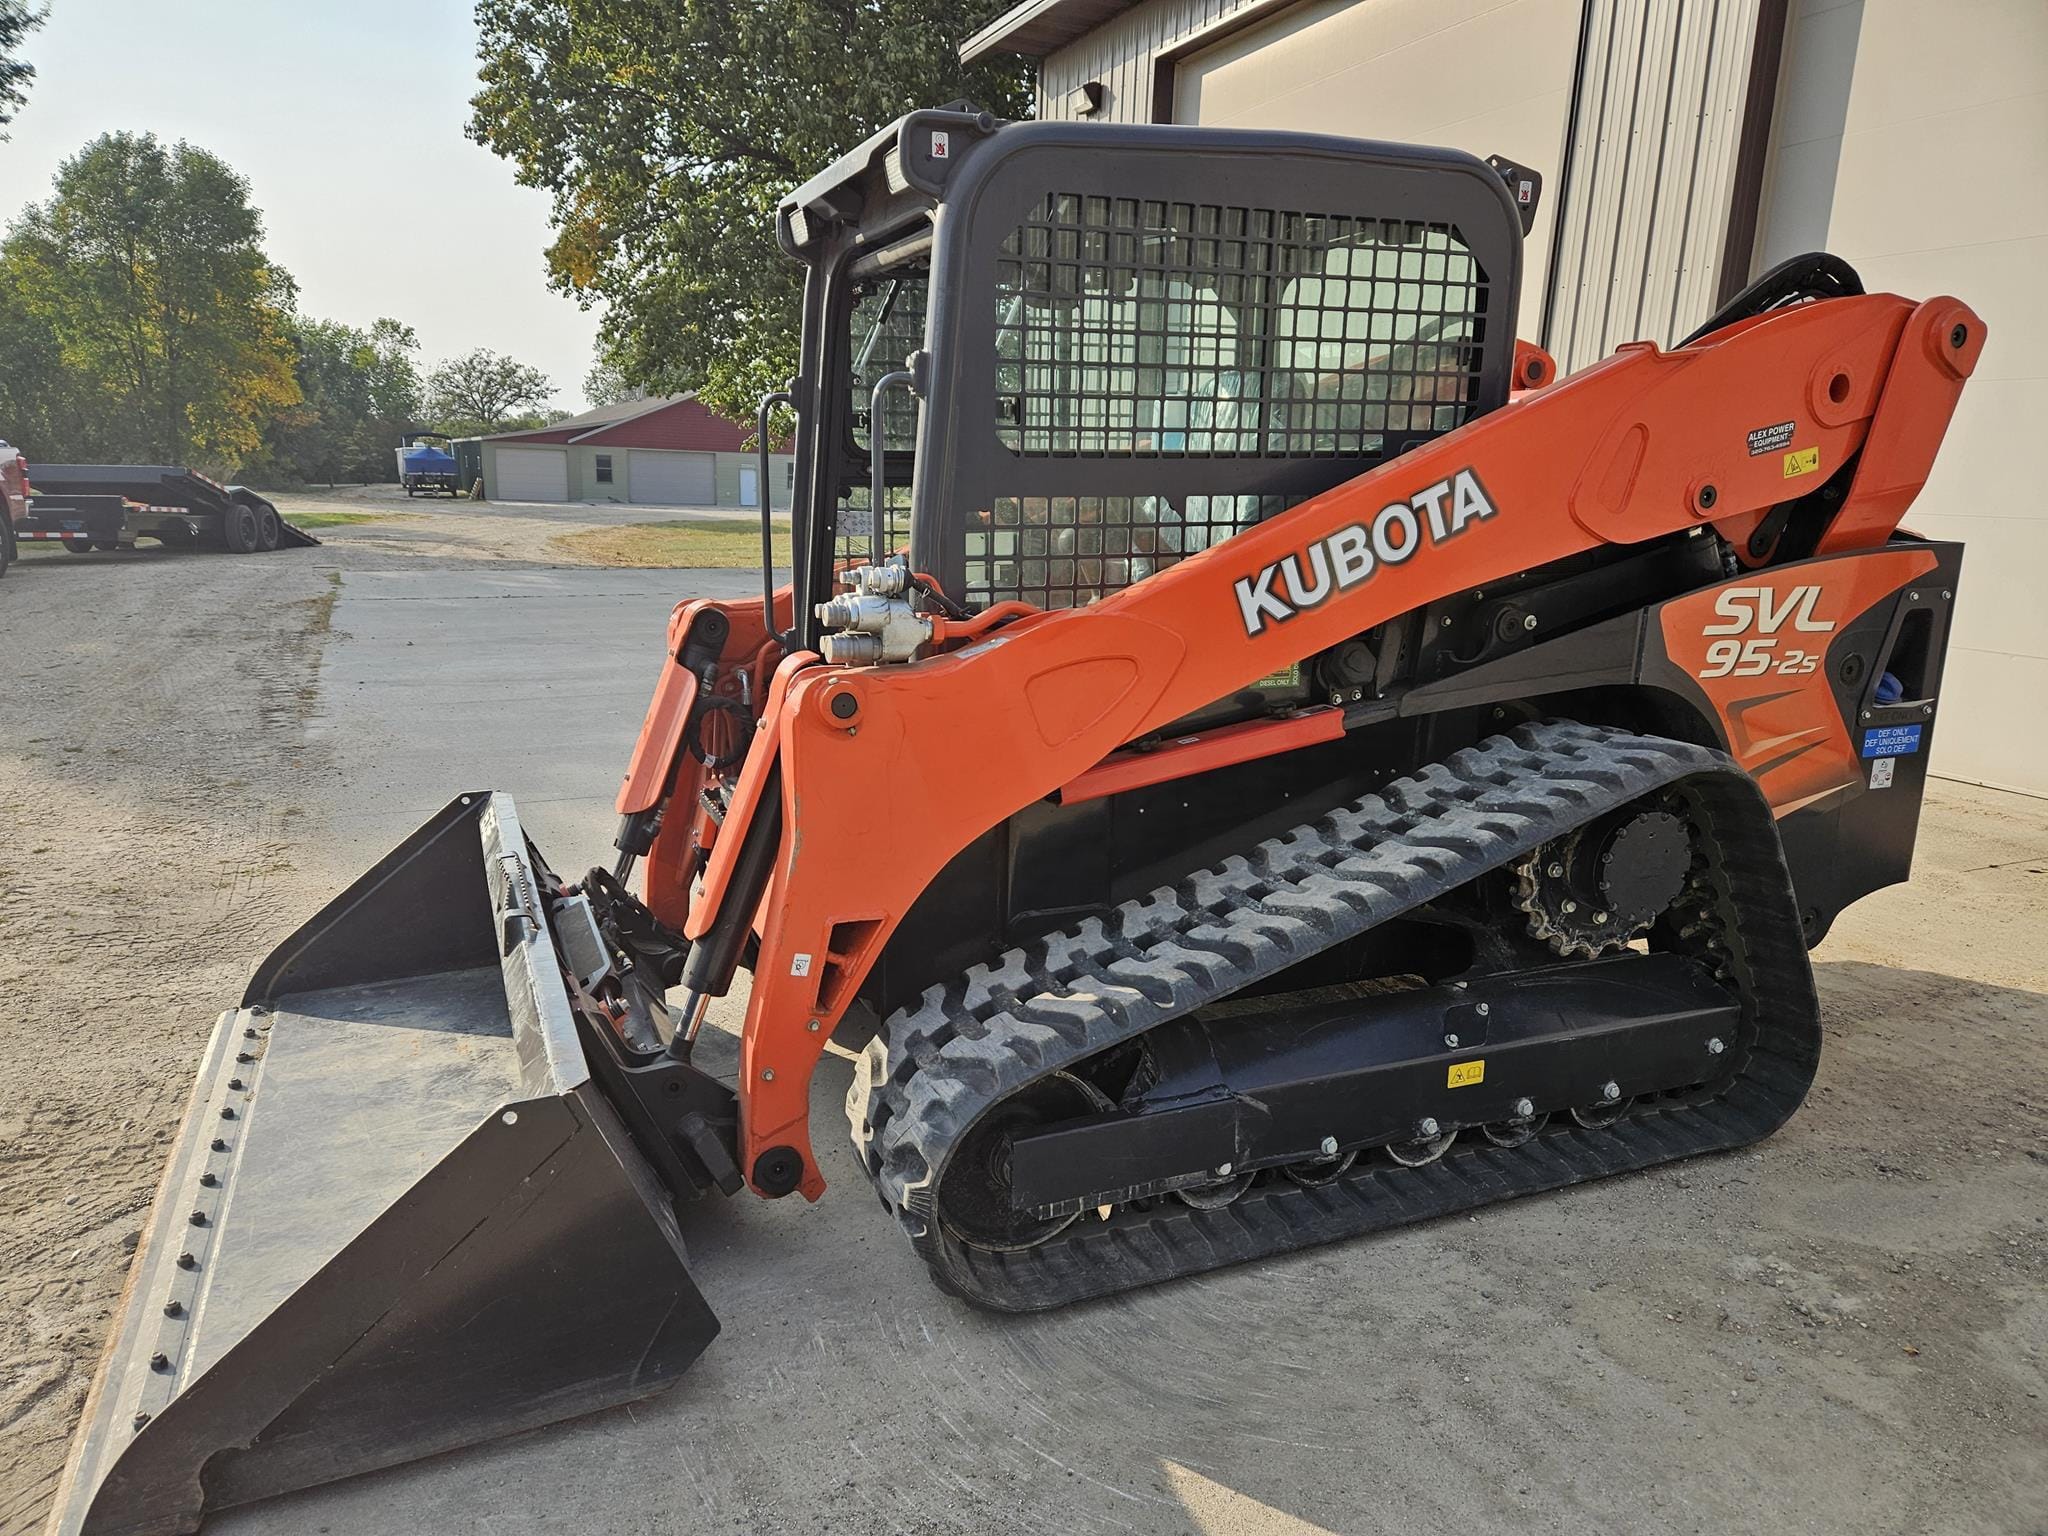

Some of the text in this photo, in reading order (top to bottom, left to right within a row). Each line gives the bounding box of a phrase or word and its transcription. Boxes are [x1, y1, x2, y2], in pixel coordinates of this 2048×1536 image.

[1748, 422, 1795, 441] ALEX POWER
[1754, 433, 1788, 448] EQUIPMENT
[1234, 469, 1493, 635] KUBOTA
[1702, 586, 1836, 636] SVL
[1878, 729, 1891, 737] DEF
[1864, 735, 1919, 747] DEF UNIQUEMENT
[1875, 744, 1906, 755] SOLO DEF
